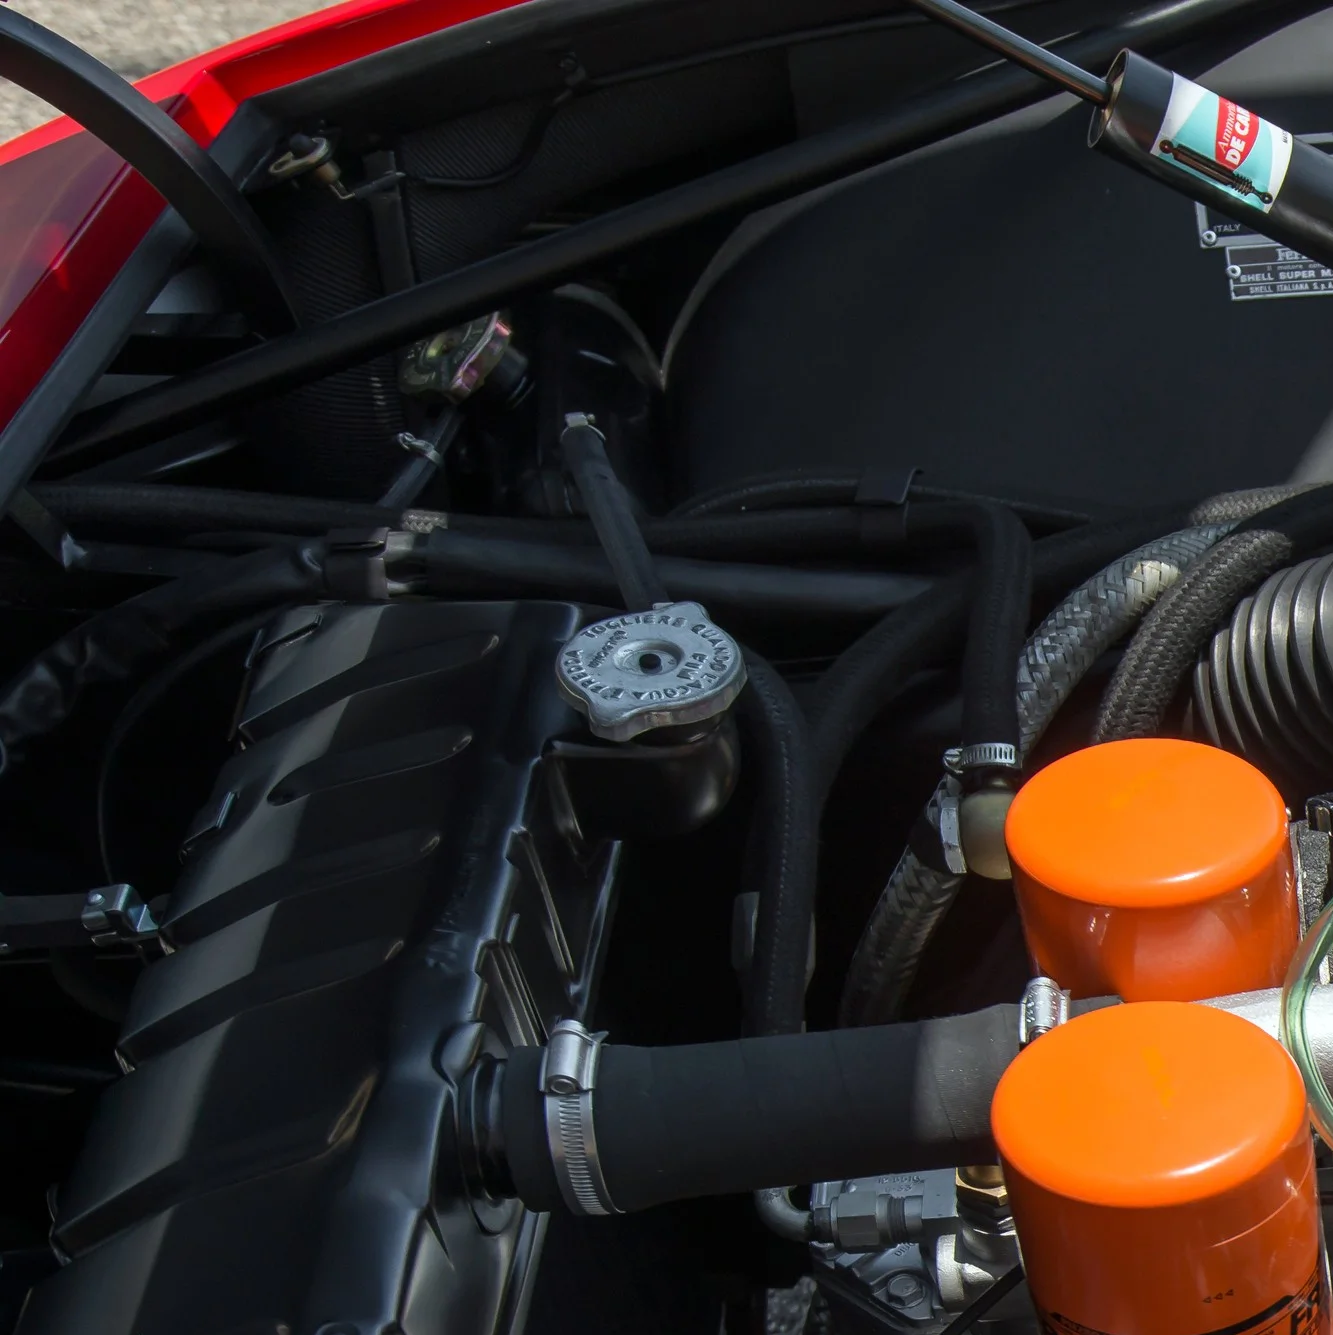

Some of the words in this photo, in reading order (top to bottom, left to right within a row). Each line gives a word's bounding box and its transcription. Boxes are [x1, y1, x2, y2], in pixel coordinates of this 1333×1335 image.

[1225, 136, 1246, 166] DE
[1213, 223, 1241, 232] ITALY
[1239, 272, 1274, 283] SHELL
[1279, 270, 1315, 280] SUPER
[1249, 284, 1274, 294] SHELL
[581, 614, 688, 639] TOGLIERE
